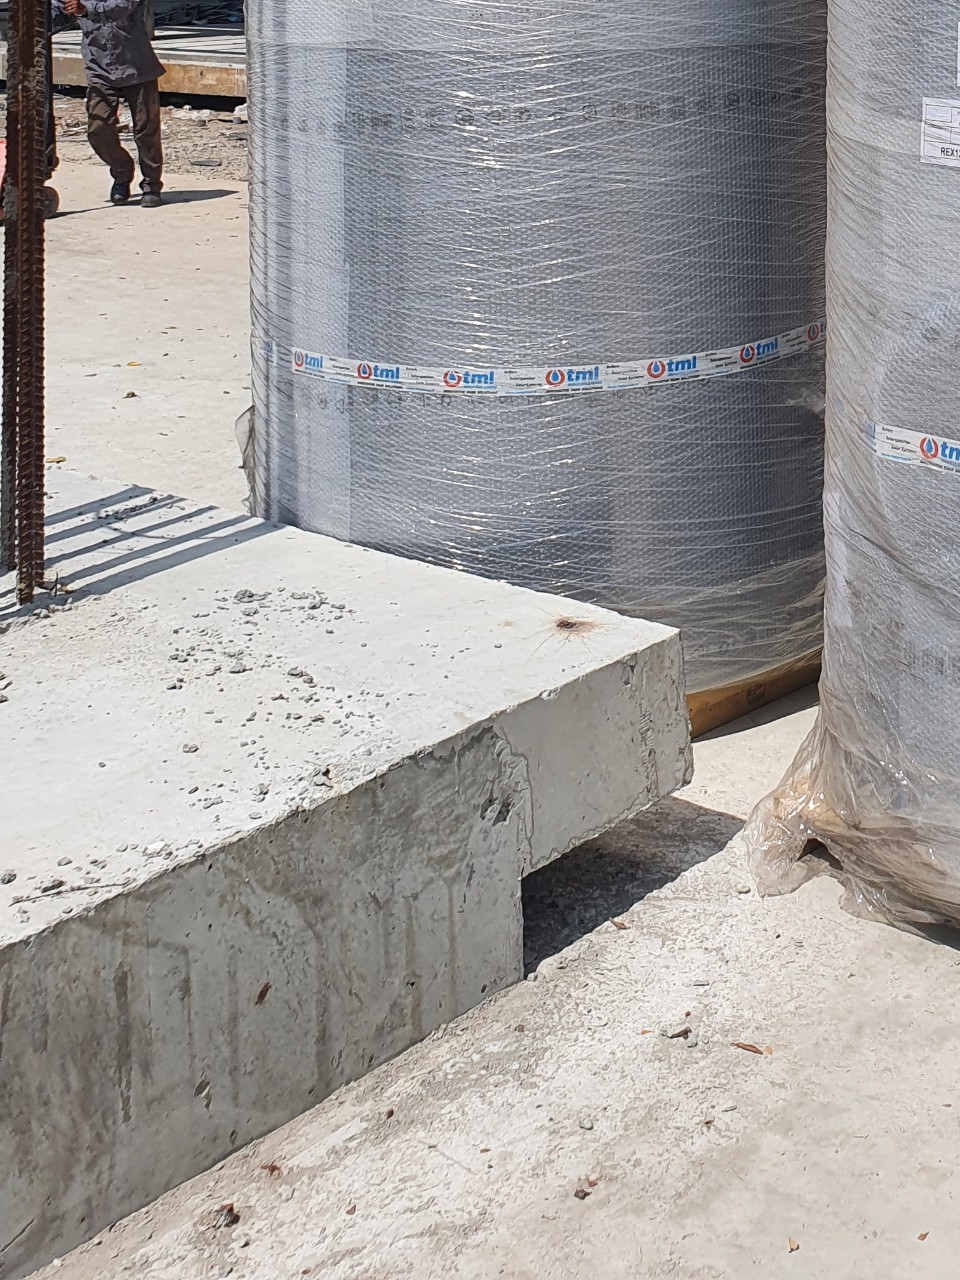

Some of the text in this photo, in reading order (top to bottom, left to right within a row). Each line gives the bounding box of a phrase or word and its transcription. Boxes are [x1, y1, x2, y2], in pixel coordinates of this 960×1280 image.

[755, 338, 778, 357] tml
[304, 353, 323, 369] tml
[666, 356, 697, 372] tml
[372, 364, 400, 380] tml
[462, 371, 494, 384] tml
[567, 366, 599, 382] tml
